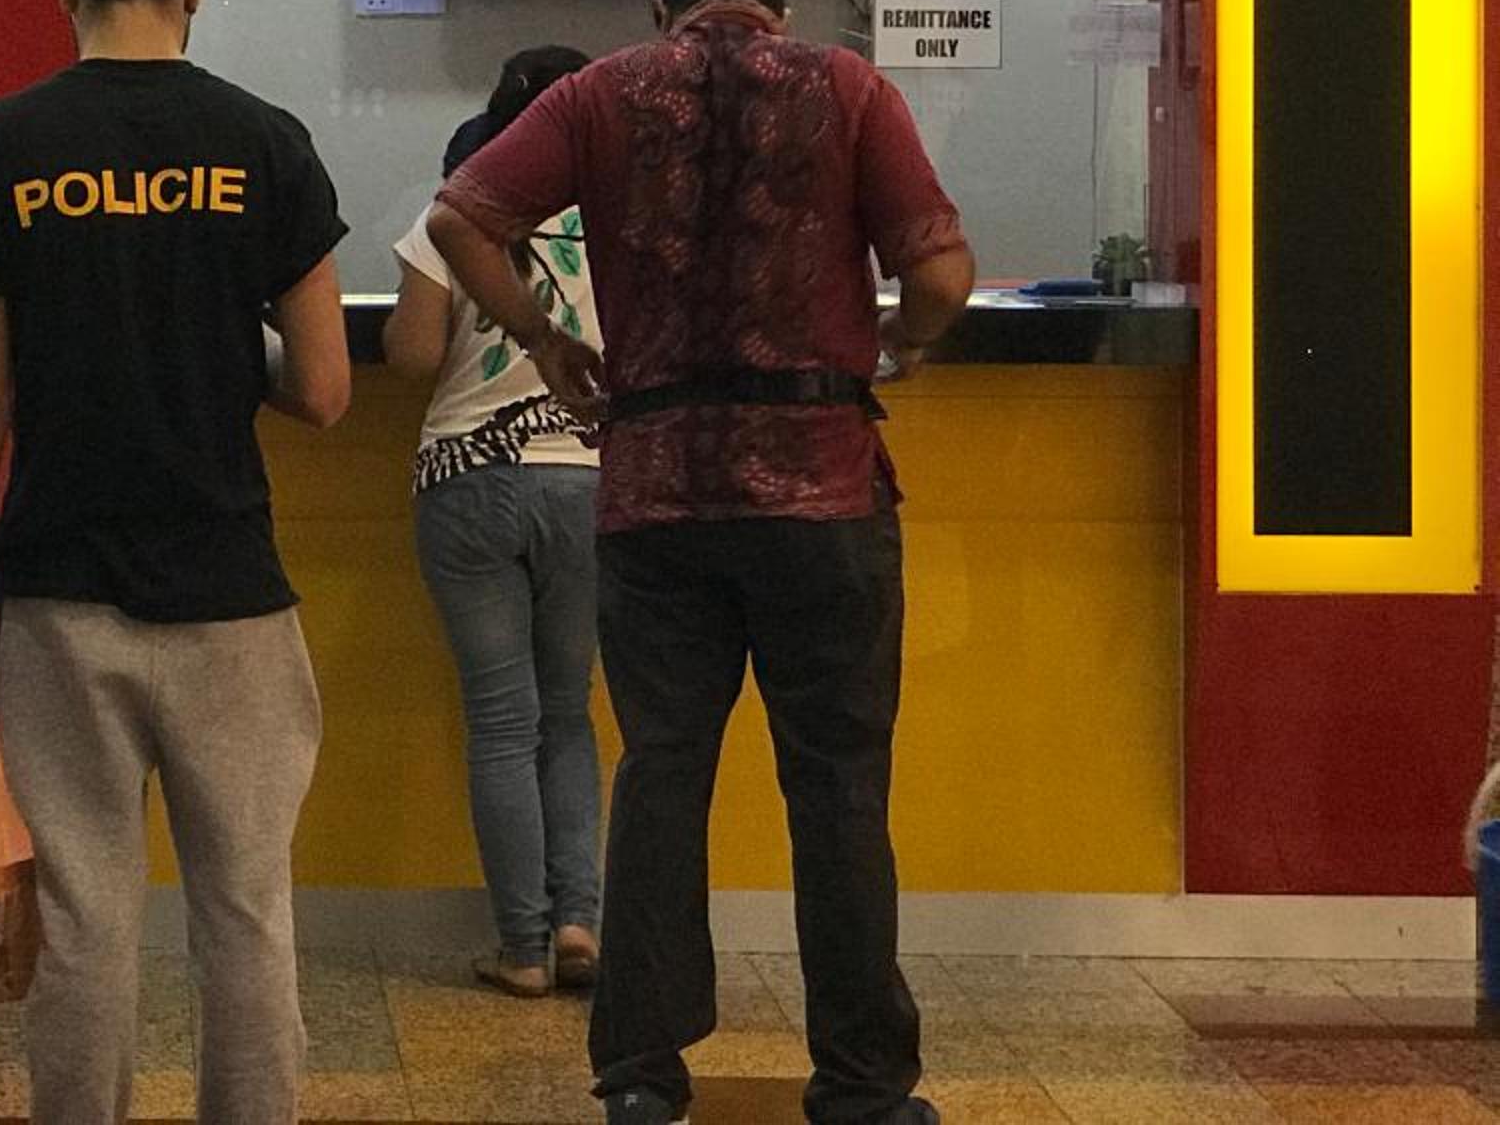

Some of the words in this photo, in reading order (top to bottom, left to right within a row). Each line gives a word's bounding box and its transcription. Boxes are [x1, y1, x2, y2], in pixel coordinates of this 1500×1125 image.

[882, 9, 991, 30] REMITTANCE
[915, 38, 959, 58] ONLY
[13, 166, 247, 228] POLICIE
